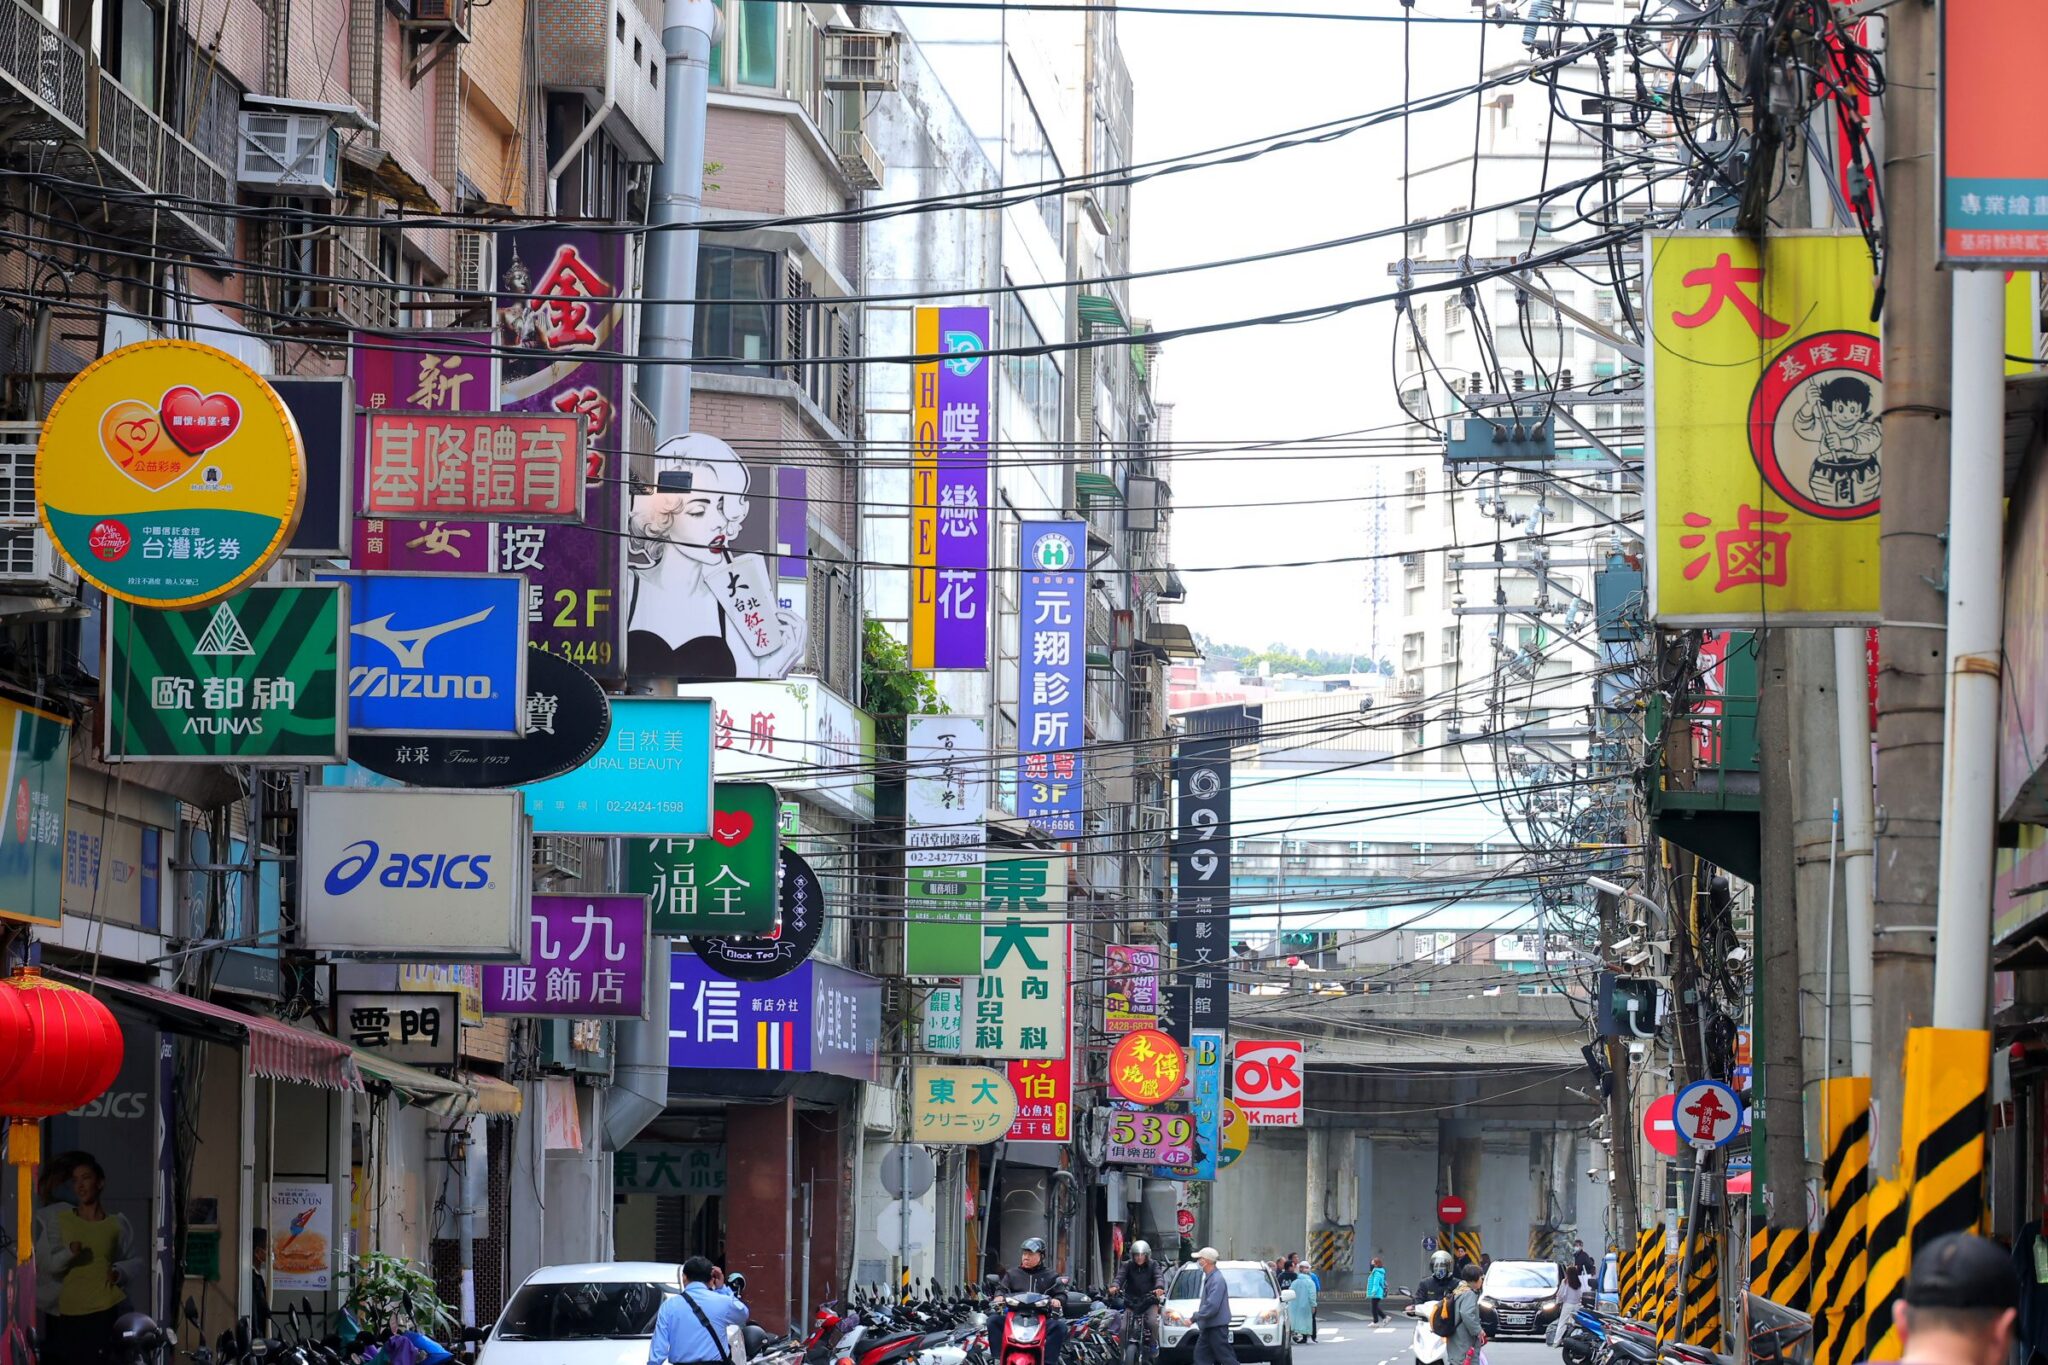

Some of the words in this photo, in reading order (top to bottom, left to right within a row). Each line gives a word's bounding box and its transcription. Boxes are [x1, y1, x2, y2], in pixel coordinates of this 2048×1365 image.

[530, 244, 615, 350] 金
[1672, 252, 1791, 340] 大
[1778, 342, 1882, 383] 基隆周
[134, 460, 181, 472] 公益彩券
[373, 421, 567, 510] 基隆體育
[919, 372, 936, 604] HOTEL
[1835, 478, 1857, 504] 周
[938, 402, 980, 620] 蝶戀花
[142, 537, 241, 560] 台灣彩券
[501, 525, 546, 571] 按
[1678, 504, 1792, 592] 滷
[552, 589, 612, 628] 2F
[1032, 590, 1072, 747] 元翔診所
[152, 676, 295, 710] 歐都納
[183, 717, 263, 735] ATUNAS
[395, 745, 430, 765] 京采
[484, 754, 511, 764] 1973
[617, 730, 684, 752] 自然美
[629, 757, 683, 771] BEAUTY
[606, 801, 684, 814] 02-2424-1598
[1032, 784, 1068, 804] 3F
[911, 852, 978, 862] 02-24277381
[652, 861, 750, 916] 福全
[984, 860, 1049, 970] 東大
[727, 949, 753, 960] Black
[756, 951, 774, 960] Tea
[501, 967, 626, 1004] 服飾店
[751, 998, 799, 1013] 新店分社
[976, 976, 1004, 1050] 小兒科
[1020, 976, 1048, 1050] 內科
[349, 1006, 441, 1048] 雲門
[1234, 1053, 1301, 1095] OK
[928, 1077, 999, 1105] 東大
[923, 1112, 1001, 1132] クリニック
[1016, 1104, 1053, 1117] 心魚丸
[1263, 1111, 1298, 1124] mart
[1702, 1106, 1714, 1135] 消防栓
[1012, 1122, 1051, 1135] 豆干包
[1112, 1113, 1191, 1147] 539
[1112, 1146, 1157, 1159] 俱樂部
[1166, 1153, 1185, 1163] 4F
[272, 1197, 297, 1206] SHEN
[301, 1197, 322, 1206] YUN
